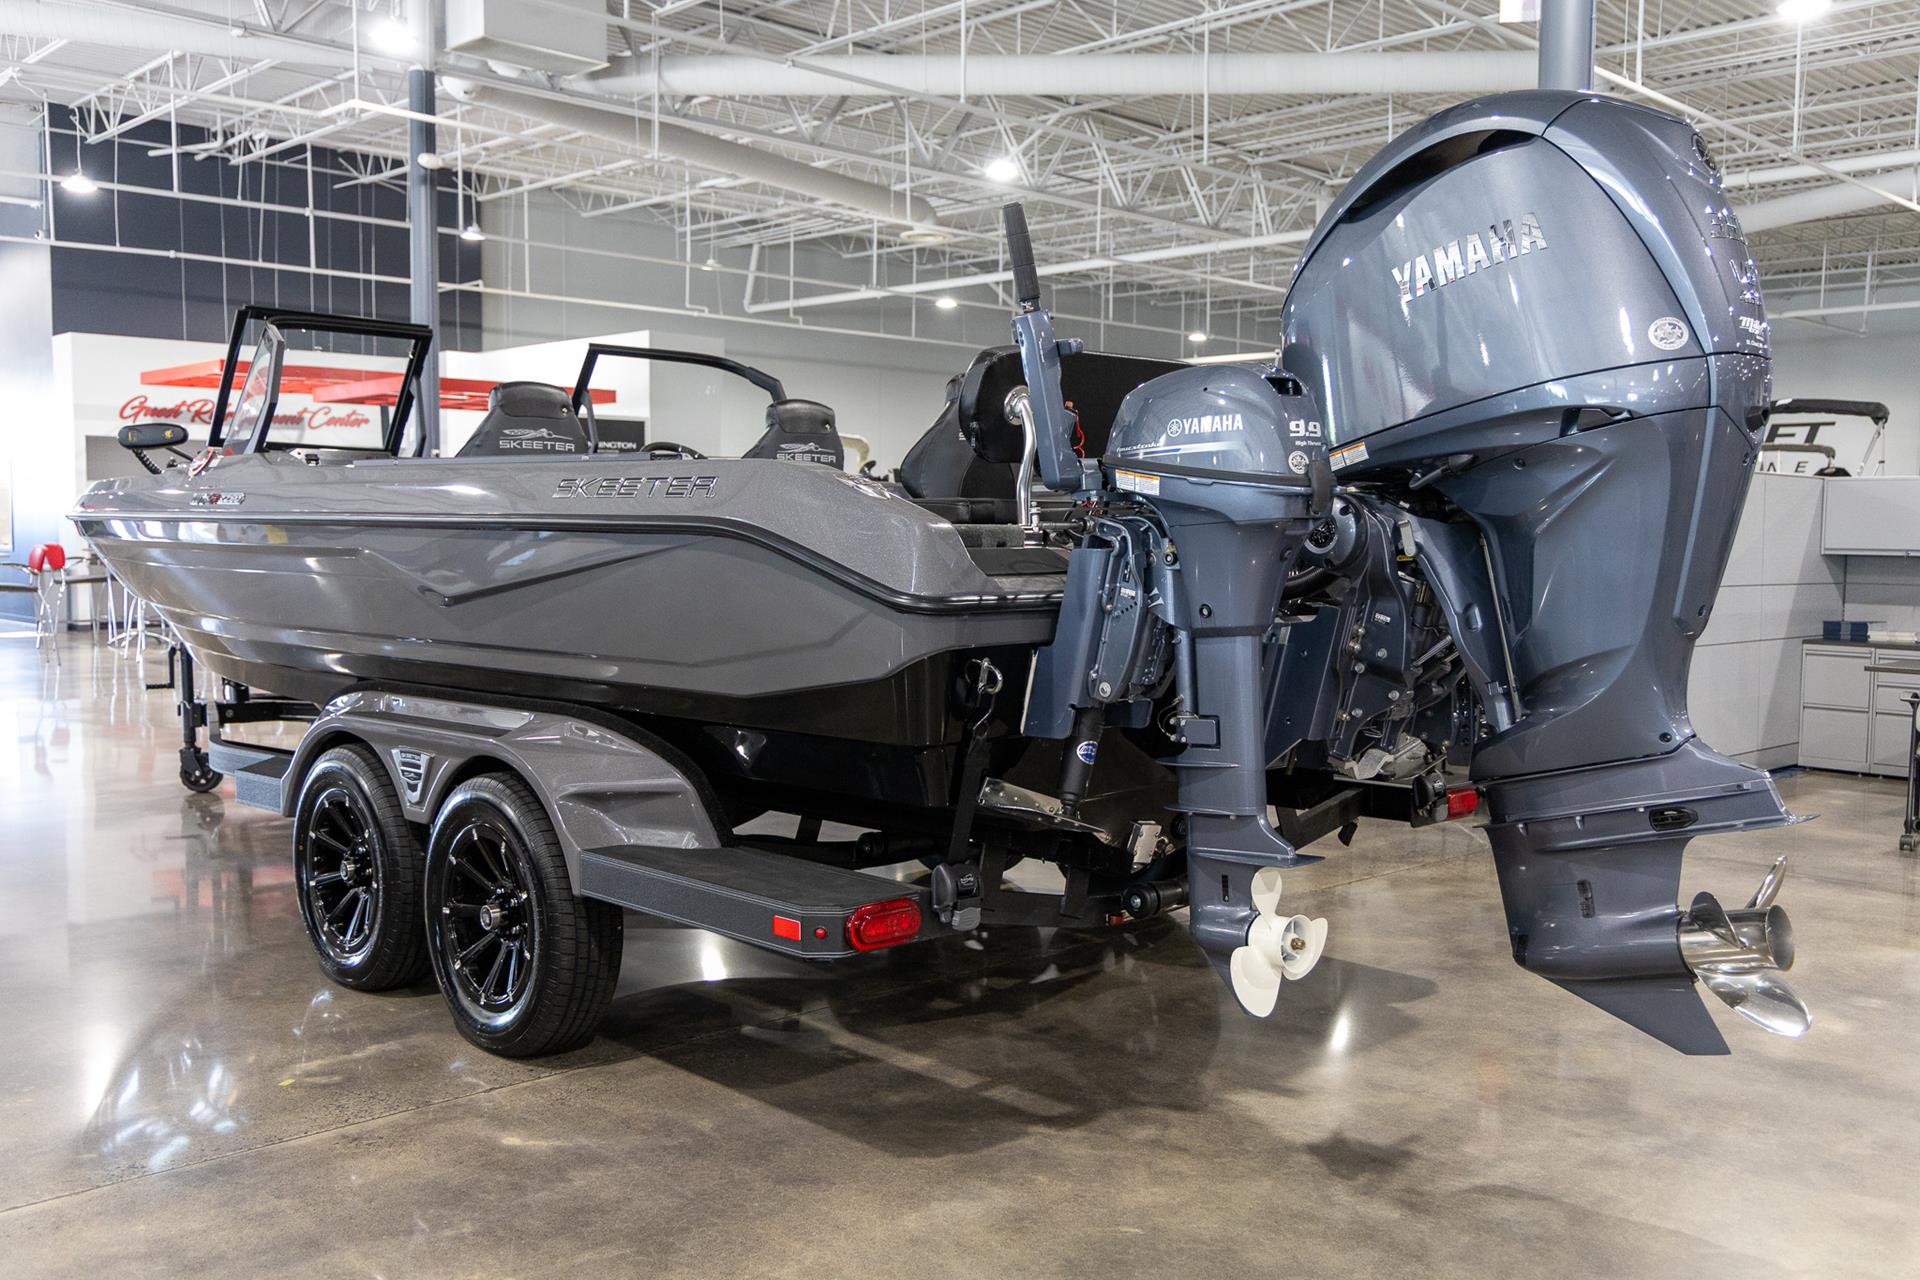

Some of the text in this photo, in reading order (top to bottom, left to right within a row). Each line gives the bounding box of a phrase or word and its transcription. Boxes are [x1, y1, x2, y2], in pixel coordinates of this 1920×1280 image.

[1391, 212, 1549, 304] YAMAHA
[308, 406, 369, 430] Center
[1183, 414, 1243, 434] YAMAHA
[1289, 419, 1321, 437] 9.9
[499, 440, 575, 452] SKEETER
[588, 440, 637, 449] INGTON
[776, 453, 836, 463] SKEETER
[552, 475, 720, 498] SKEETER
